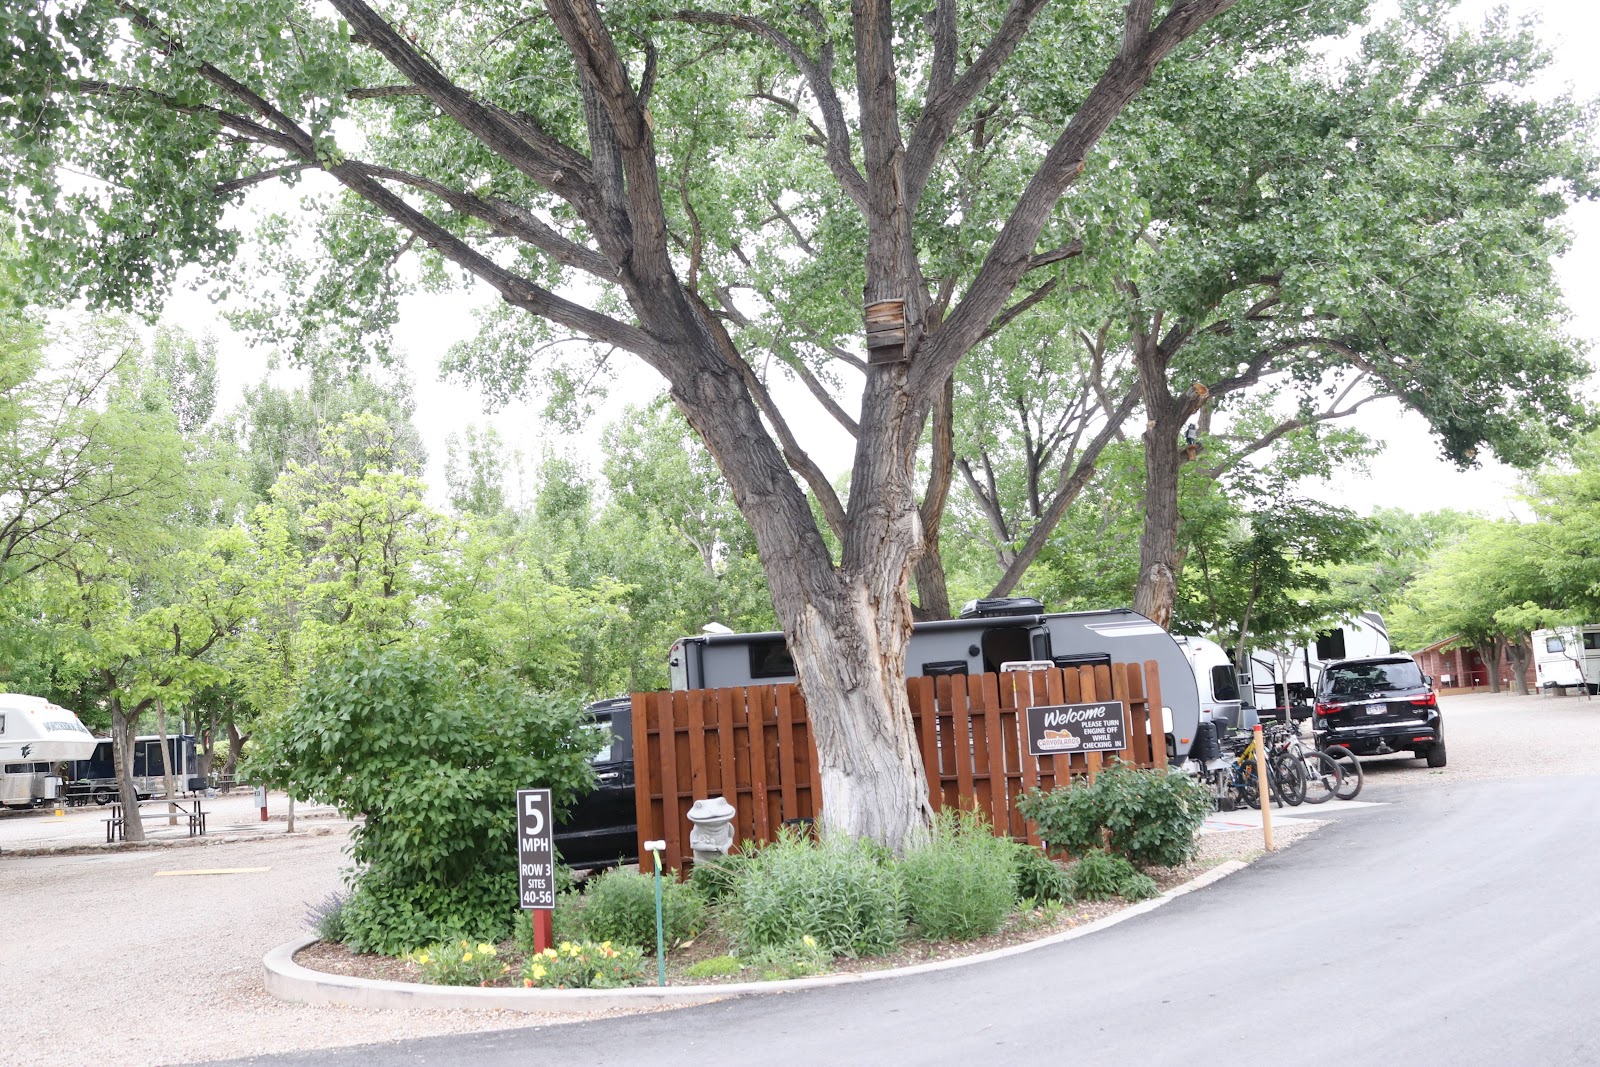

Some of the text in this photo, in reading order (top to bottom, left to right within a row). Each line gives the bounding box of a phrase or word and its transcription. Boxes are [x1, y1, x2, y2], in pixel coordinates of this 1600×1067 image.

[1044, 706, 1105, 727] Welcome
[1081, 719, 1119, 728] PLEASE TURN
[1084, 726, 1118, 735] ENGINE OFF
[1038, 737, 1080, 747] CANYONLANDS
[1092, 734, 1111, 742] WHILE
[1082, 741, 1112, 749] CHECKING
[525, 795, 544, 835] 5
[523, 838, 548, 852] MPH
[522, 864, 551, 876] ROW 3
[528, 879, 546, 889] SITES
[524, 891, 551, 903] 40-56
